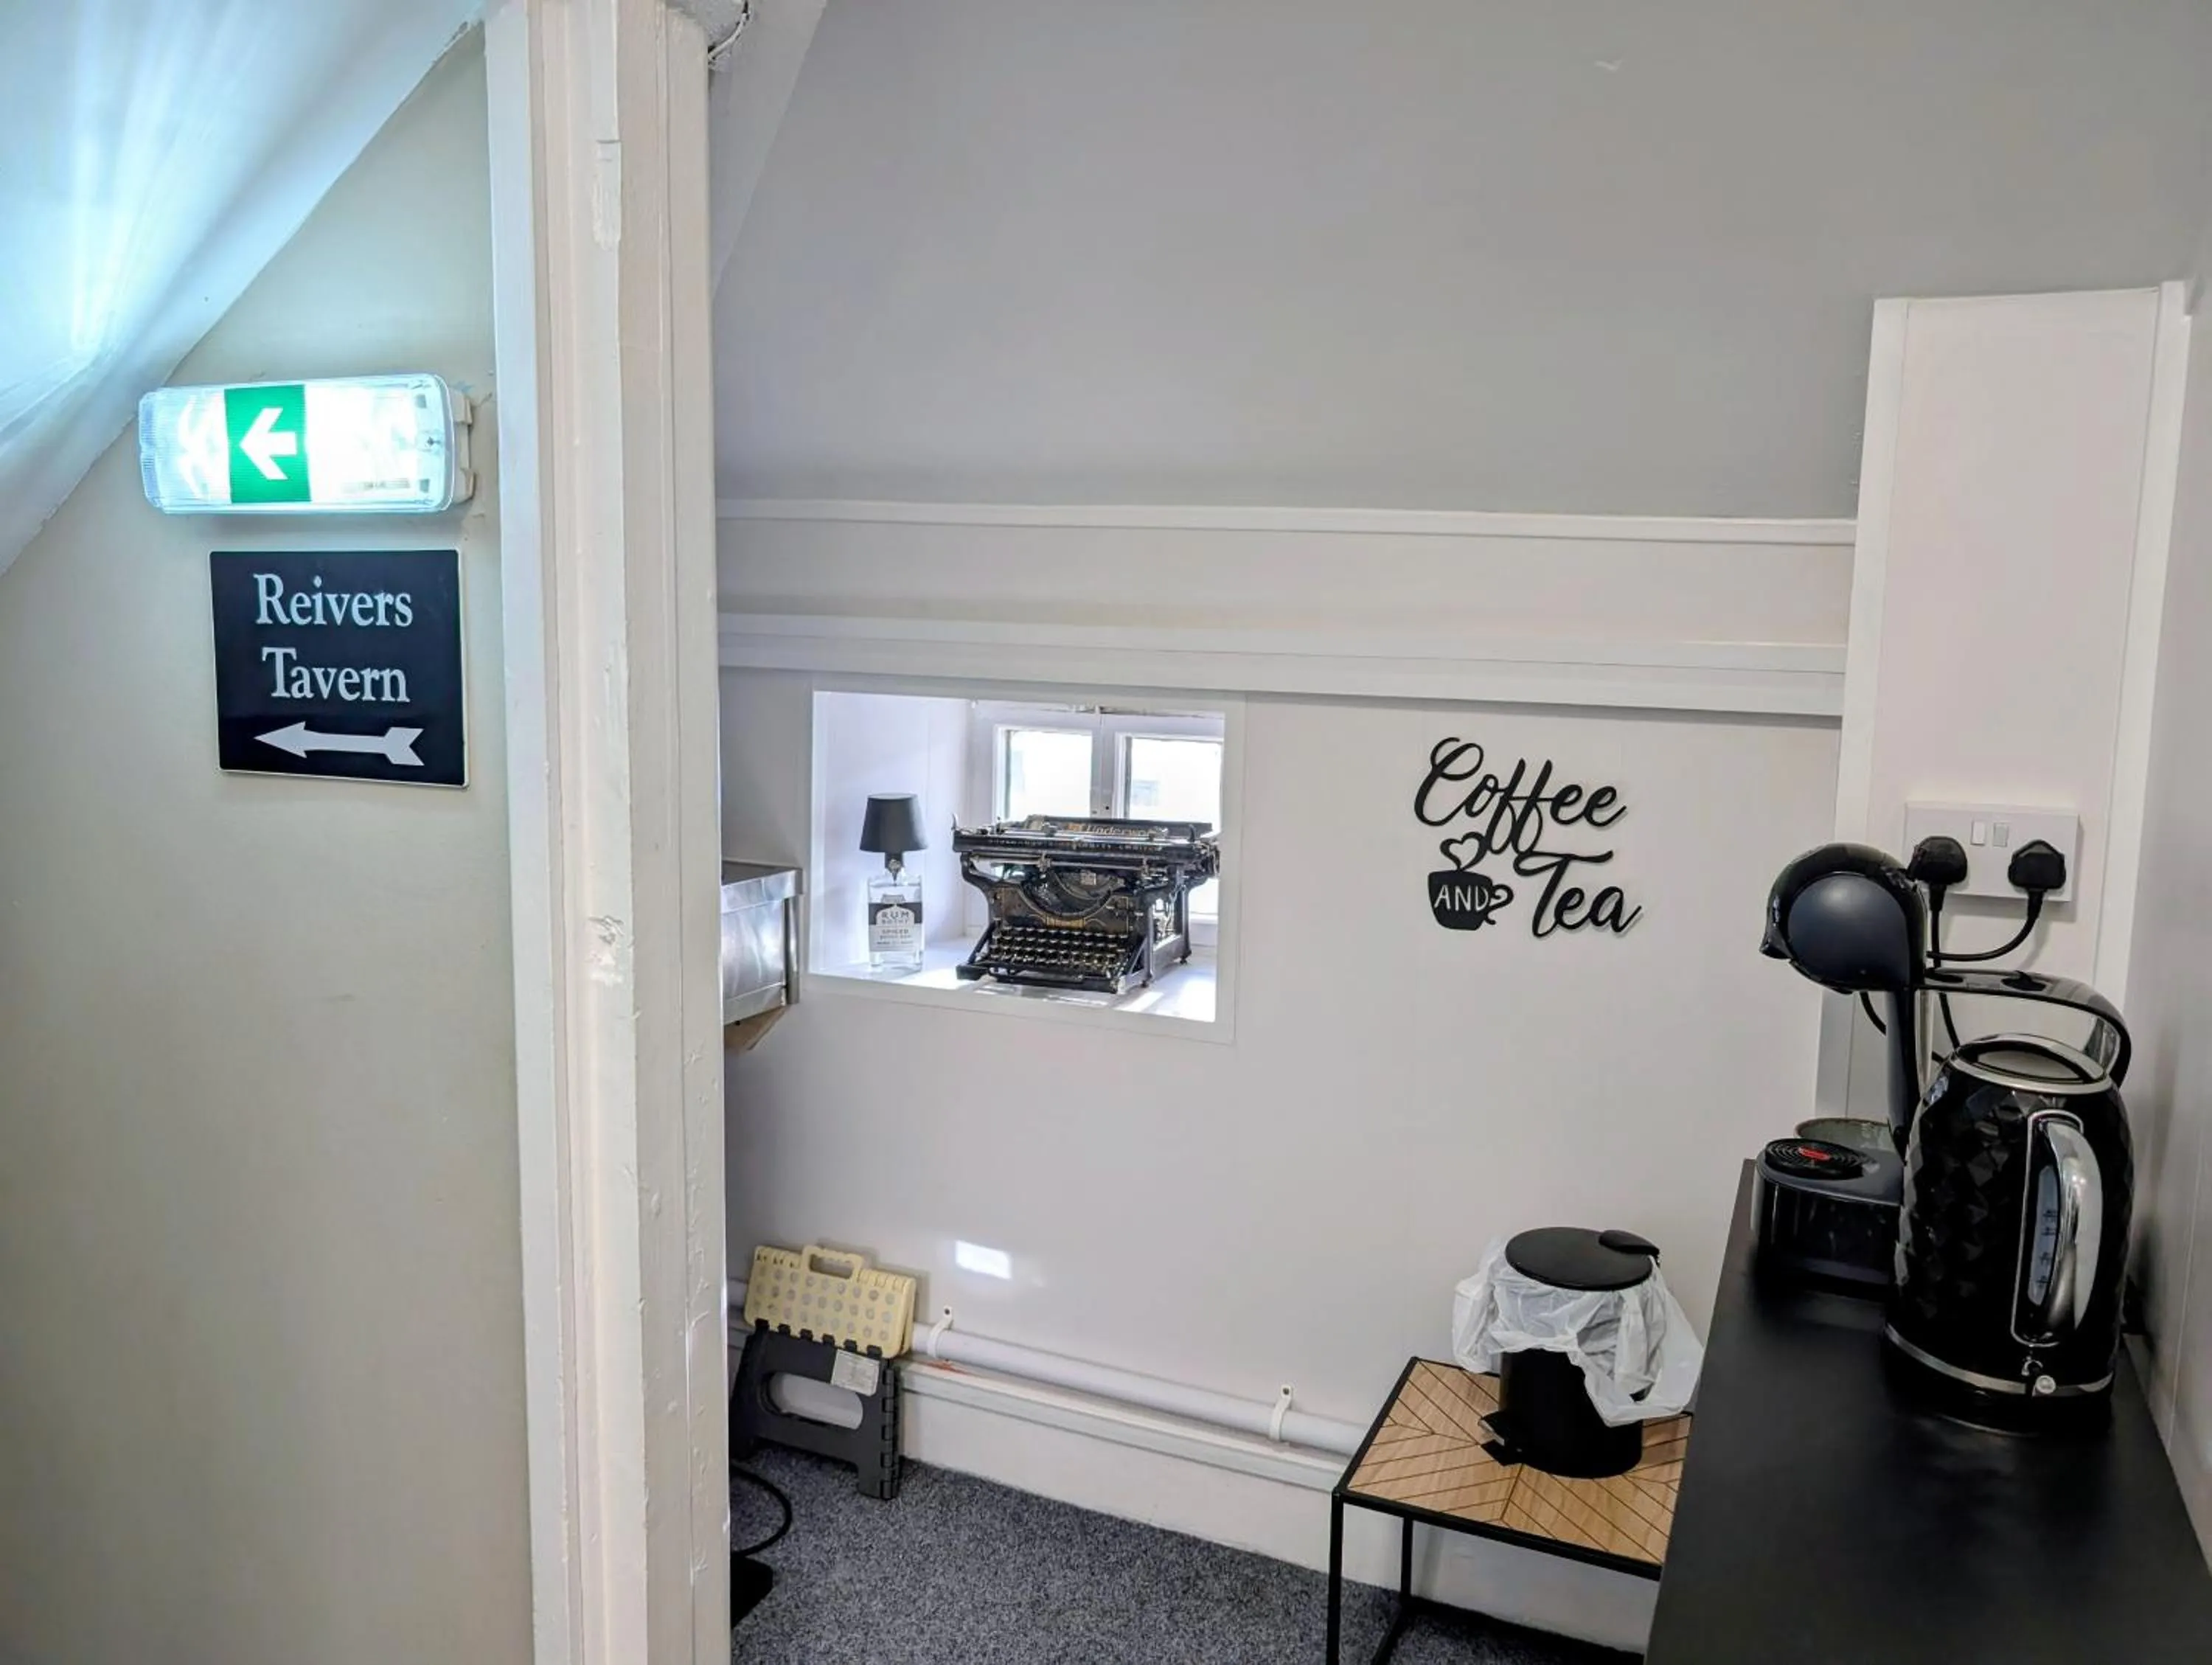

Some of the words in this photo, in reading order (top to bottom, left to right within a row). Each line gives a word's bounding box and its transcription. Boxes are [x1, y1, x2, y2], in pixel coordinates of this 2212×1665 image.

[253, 573, 413, 628] Reivers
[262, 646, 410, 703] Tavern
[1414, 737, 1627, 855] Coffee
[881, 911, 909, 920] RUM
[1434, 885, 1489, 911] AND
[1513, 850, 1642, 938] Tea
